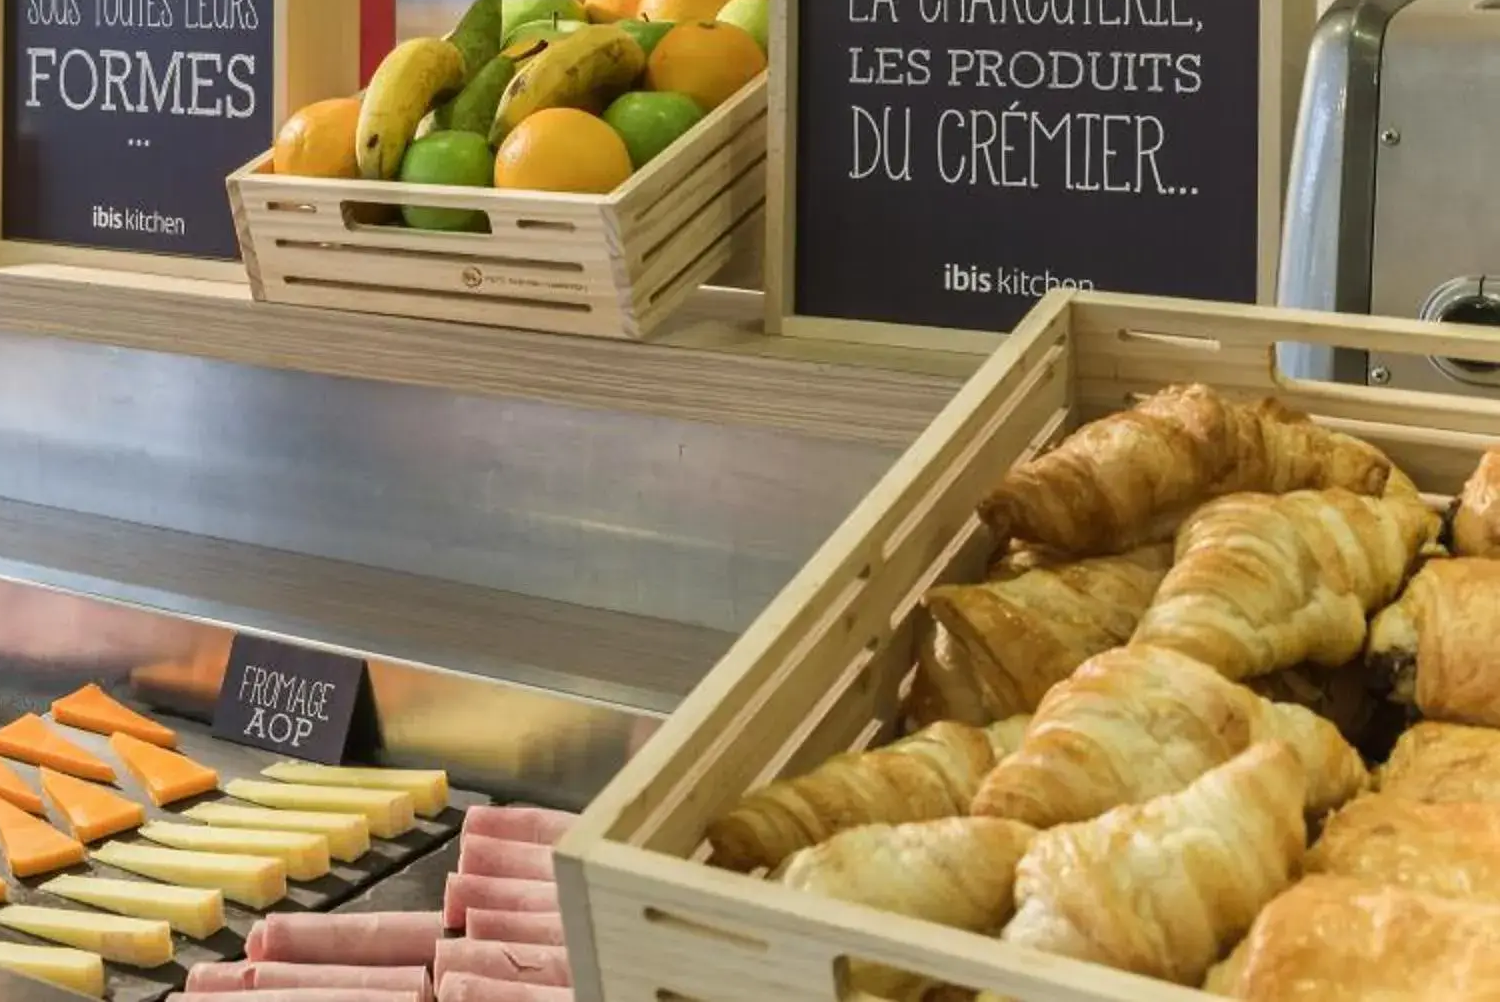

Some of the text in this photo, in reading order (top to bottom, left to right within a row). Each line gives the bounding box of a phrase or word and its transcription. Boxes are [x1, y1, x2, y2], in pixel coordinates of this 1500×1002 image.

[25, 47, 256, 120] FORMES
[848, 46, 1203, 95] LES PRODUITS
[848, 100, 1200, 196] DU CRÉMIER...
[92, 205, 186, 236] ibis kitchen
[943, 262, 992, 293] ibis
[238, 665, 336, 722] FROMAGE
[243, 706, 313, 747] AOP
